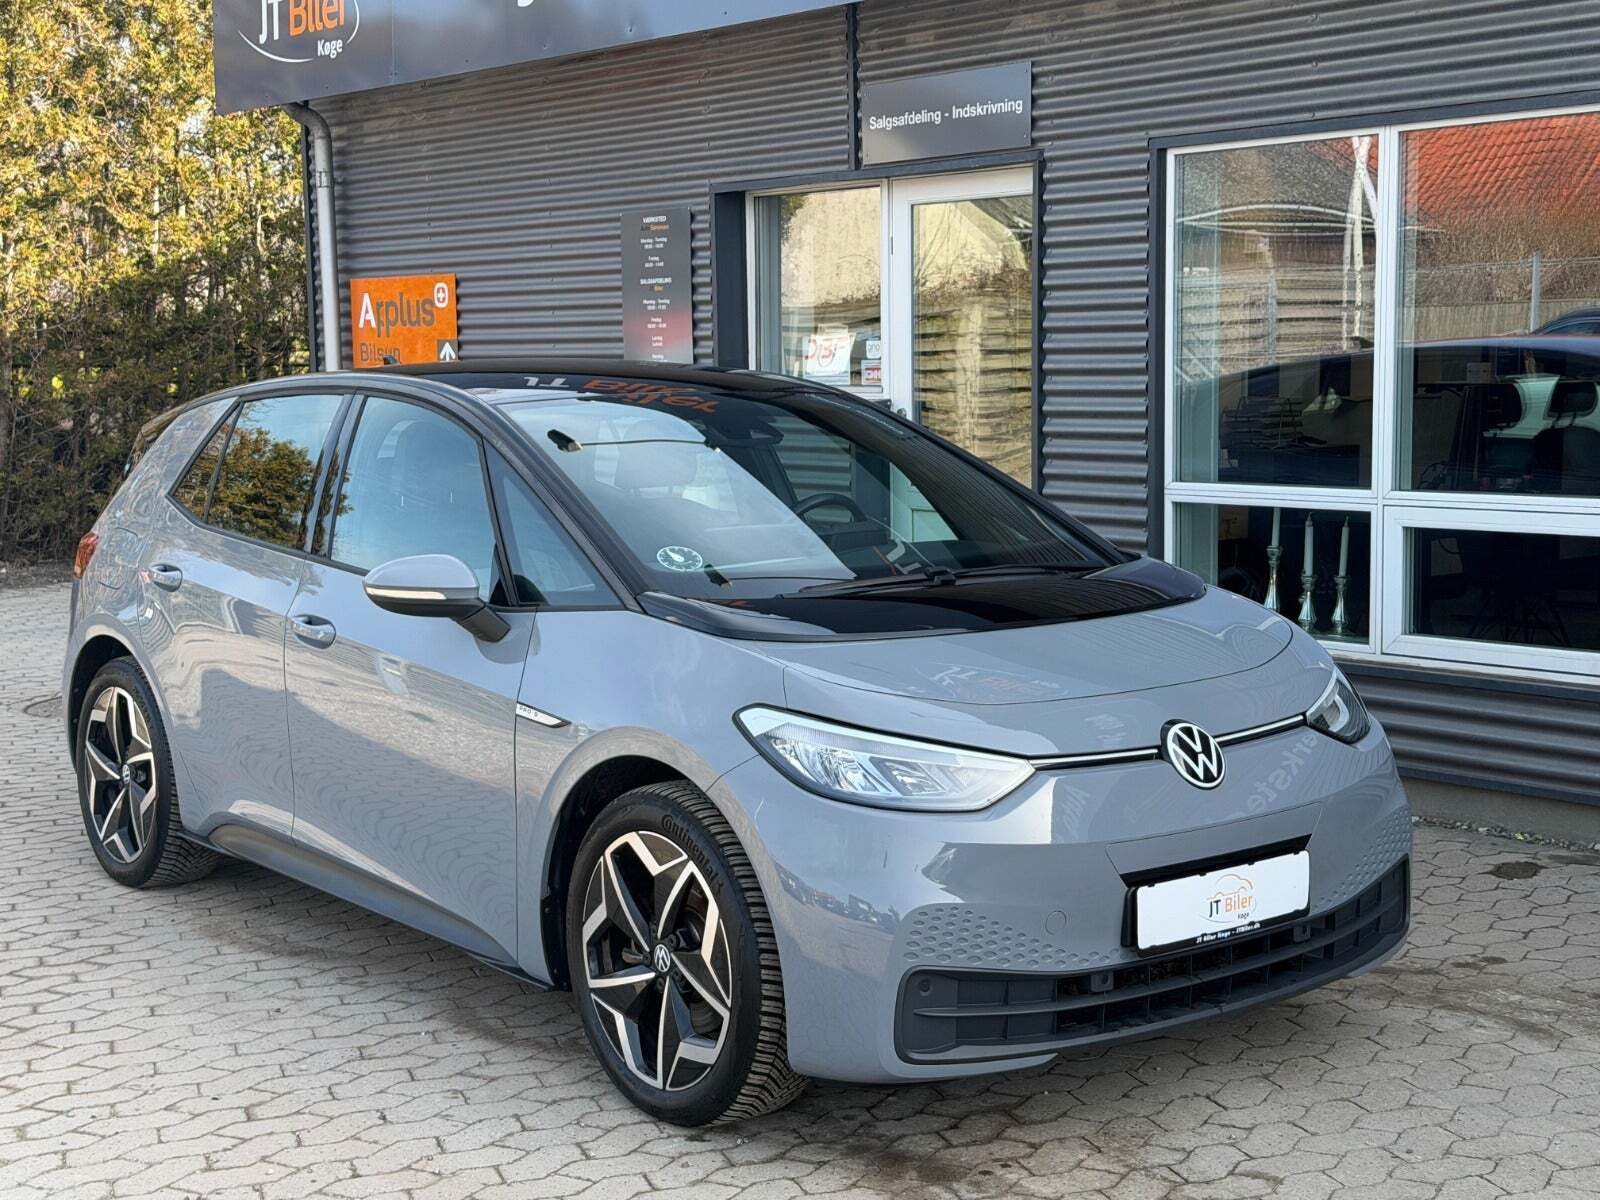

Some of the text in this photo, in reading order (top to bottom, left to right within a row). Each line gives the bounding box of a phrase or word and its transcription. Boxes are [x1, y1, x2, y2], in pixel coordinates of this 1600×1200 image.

[317, 39, 343, 59] Køge
[869, 110, 941, 130] Salgsafdeling
[952, 99, 1023, 119] Indskrivning
[1208, 895, 1253, 918] JT Biler
